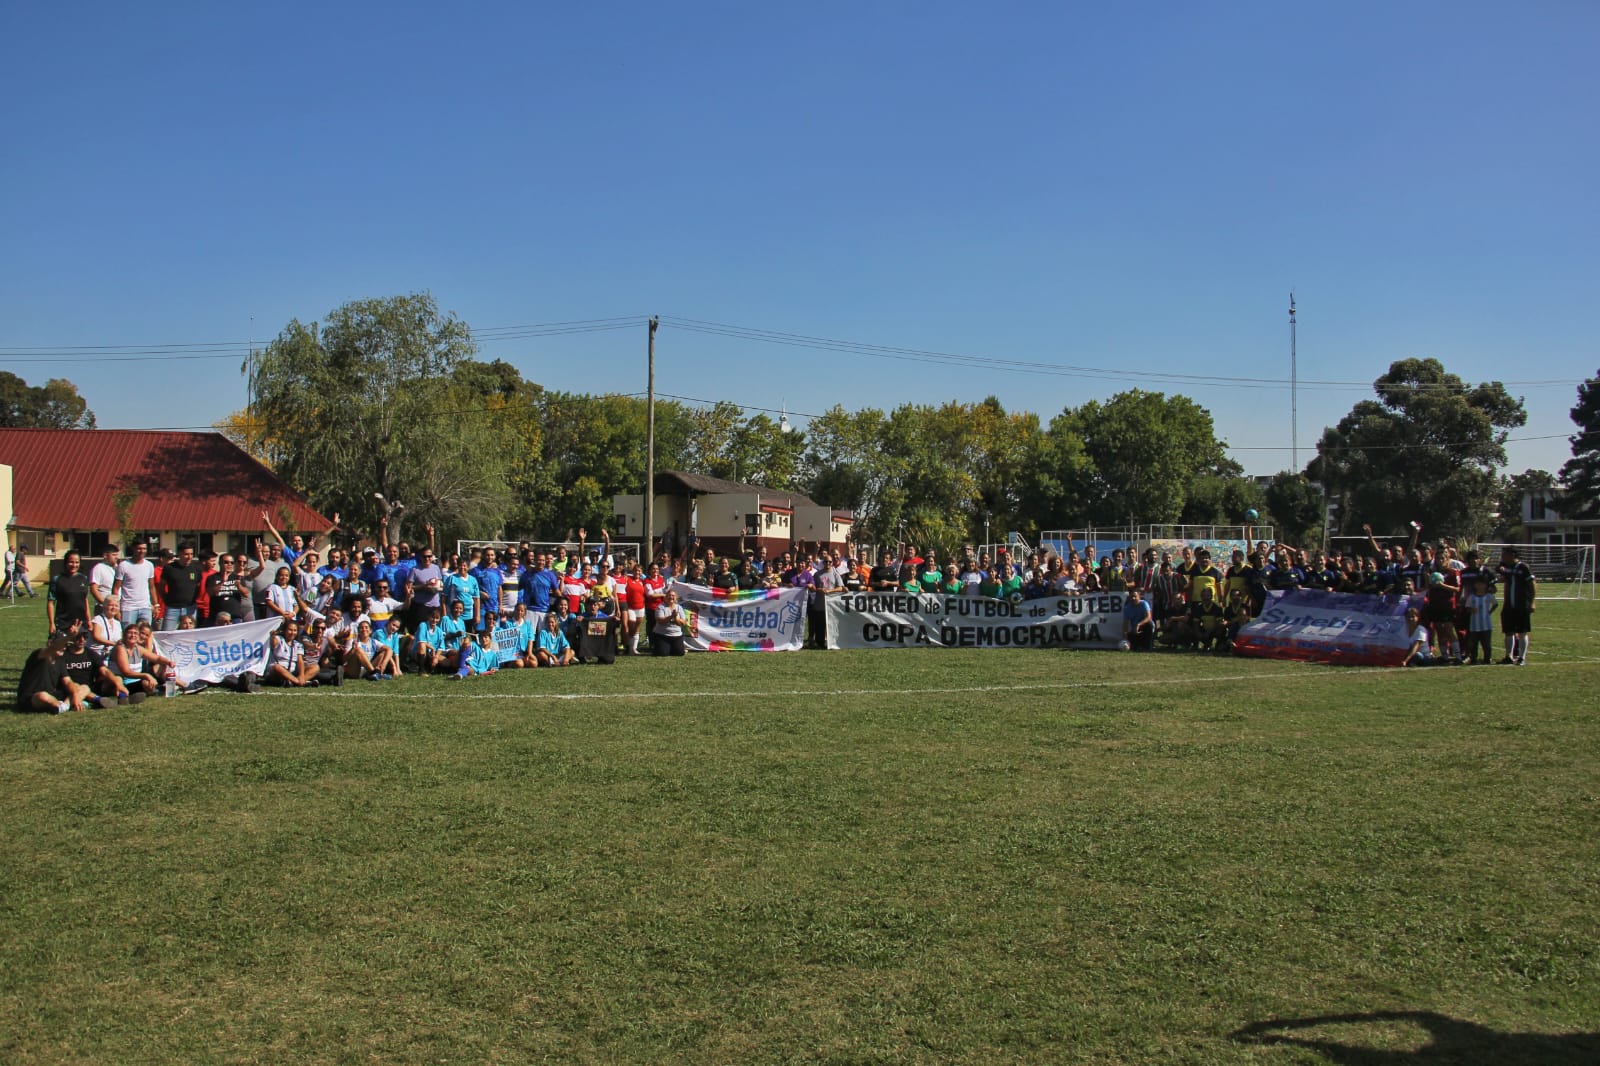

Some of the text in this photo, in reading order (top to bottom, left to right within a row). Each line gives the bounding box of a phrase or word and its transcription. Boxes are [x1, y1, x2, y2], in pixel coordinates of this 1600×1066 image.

[708, 601, 779, 629] Suteba
[840, 595, 1123, 618] TORNEO de FUTBOL de SUTEB
[1262, 608, 1365, 631] Suteba
[862, 622, 932, 643] COPA
[195, 639, 264, 666] Suteba
